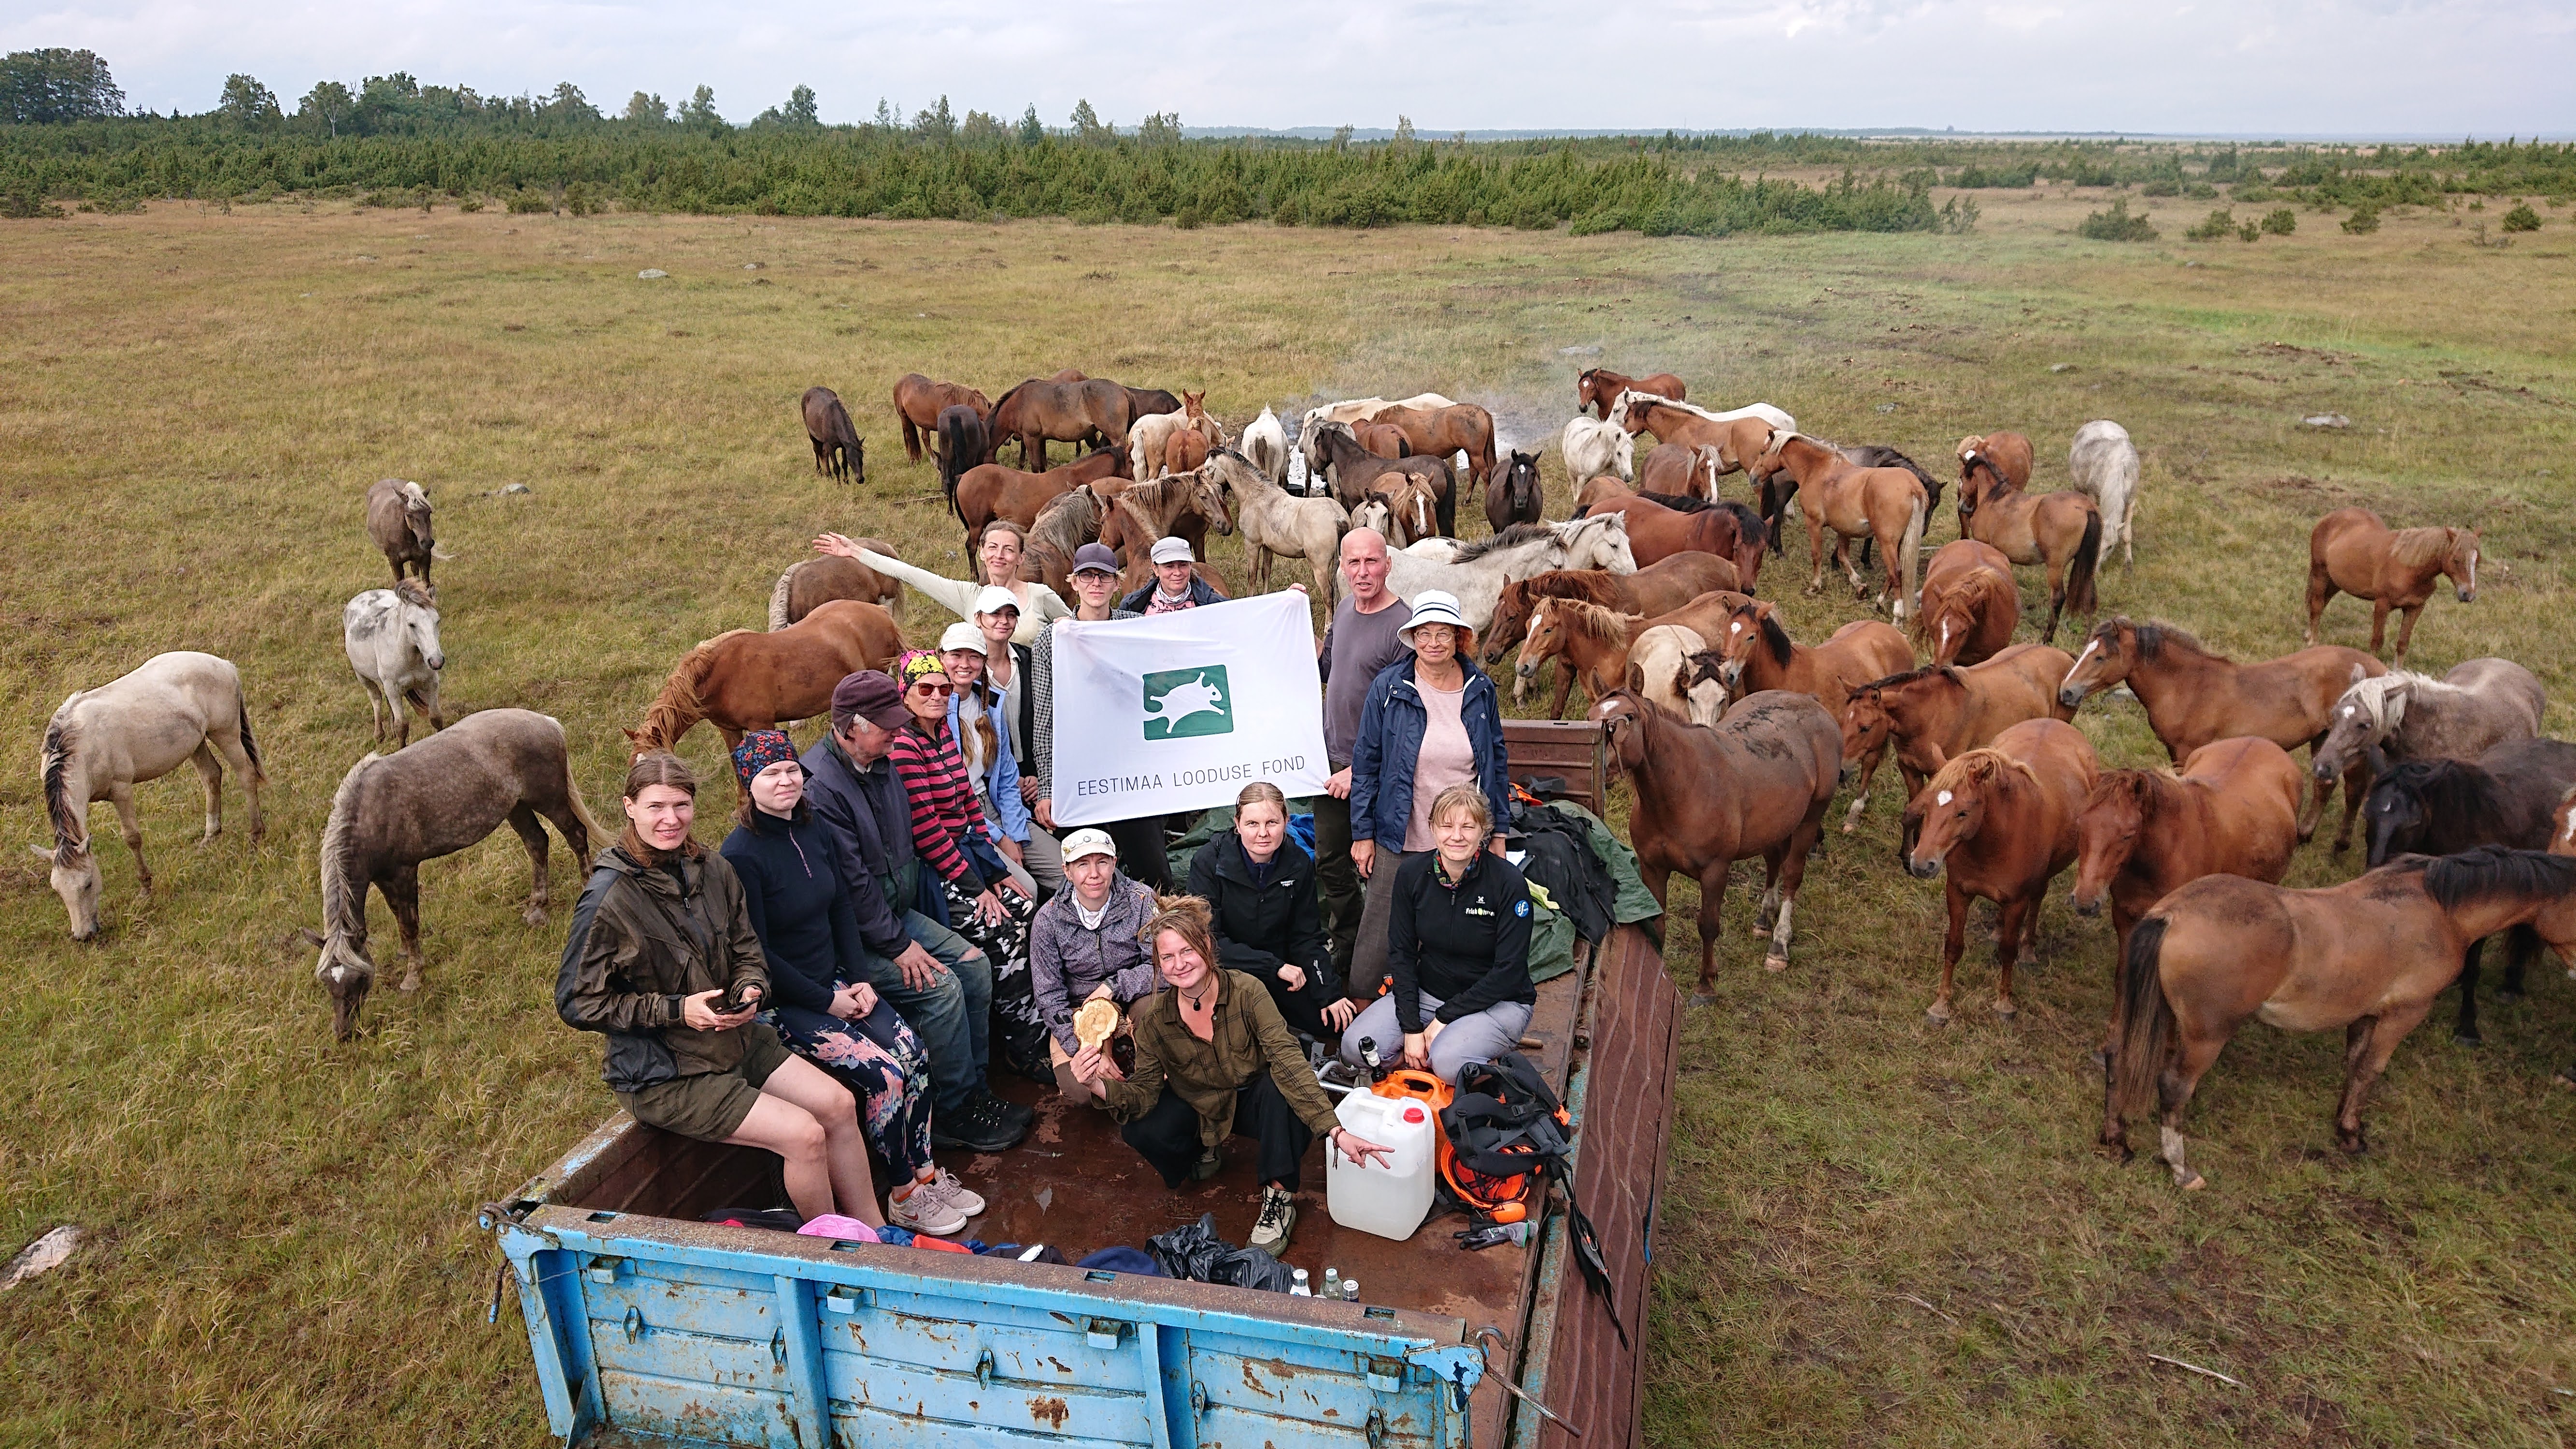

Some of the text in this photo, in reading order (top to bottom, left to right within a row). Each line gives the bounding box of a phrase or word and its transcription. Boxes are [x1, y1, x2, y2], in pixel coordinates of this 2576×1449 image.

[1078, 755, 1306, 796] EESTIMAA LOODUSE FOND
